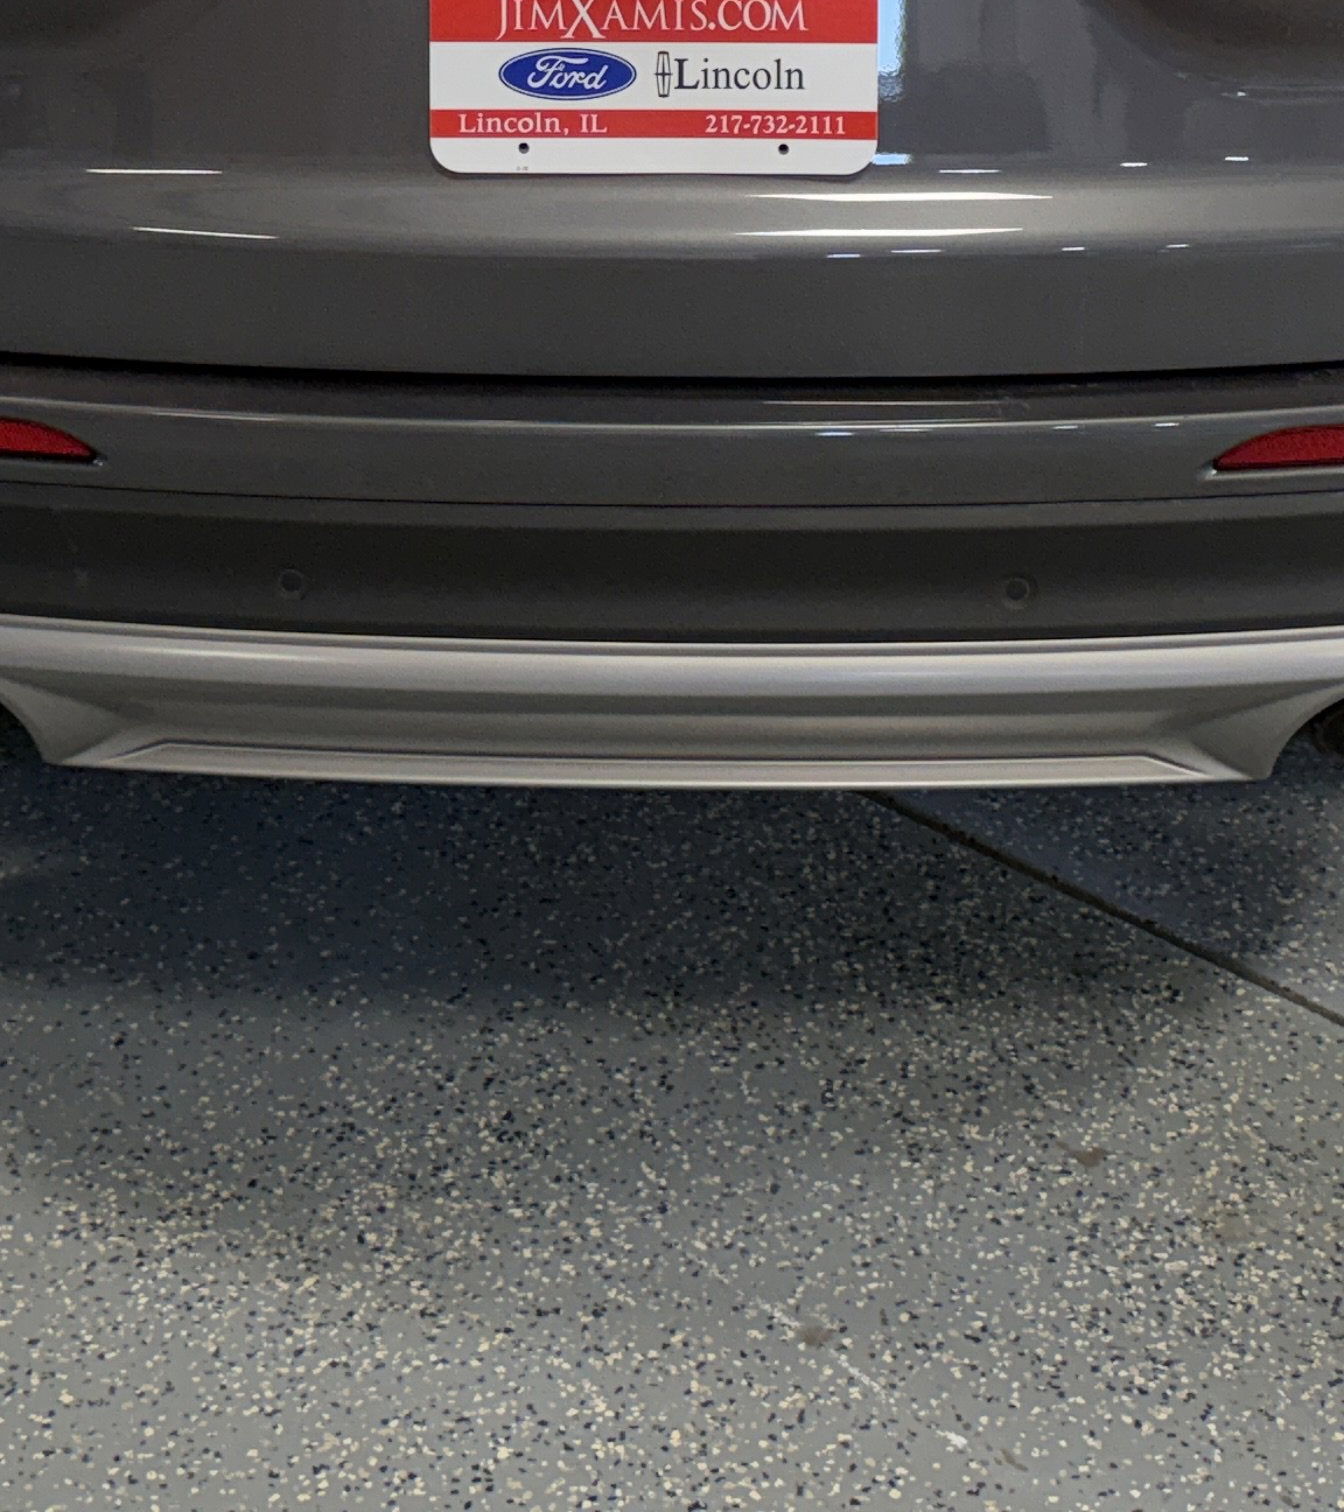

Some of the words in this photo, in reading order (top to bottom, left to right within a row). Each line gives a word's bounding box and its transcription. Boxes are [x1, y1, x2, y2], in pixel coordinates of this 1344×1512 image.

[527, 55, 608, 92] Ford
[674, 58, 805, 90] Lincoln
[459, 112, 570, 136] Lincoln,
[580, 113, 607, 133] IL
[705, 114, 846, 135] 217-732-2111
